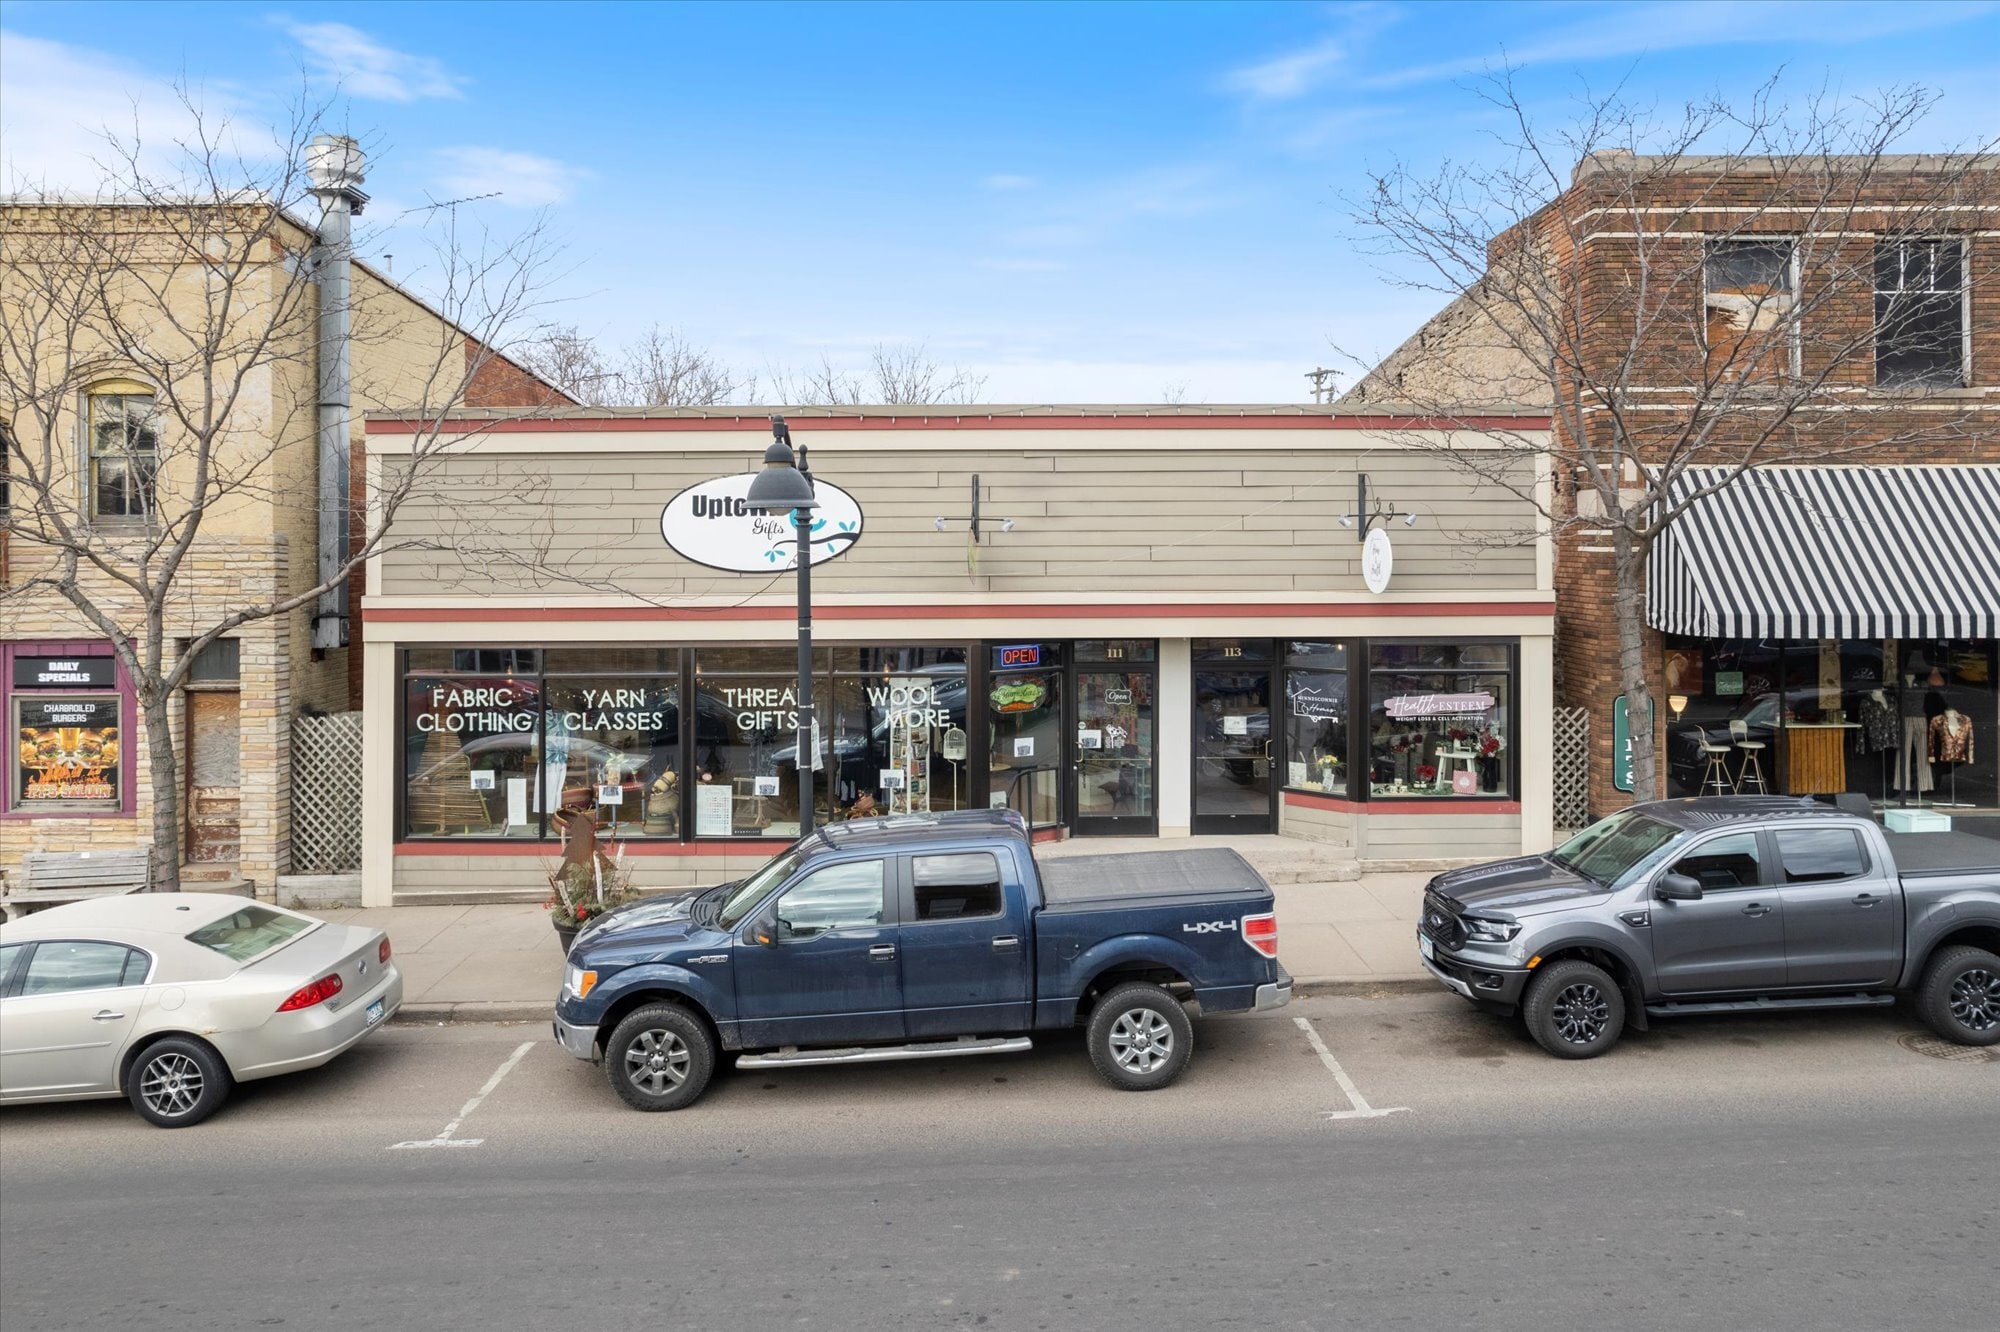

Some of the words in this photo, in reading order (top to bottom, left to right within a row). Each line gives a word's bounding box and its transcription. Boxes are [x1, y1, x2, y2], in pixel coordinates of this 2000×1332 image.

[692, 495, 776, 519] Upto
[752, 518, 785, 540] Gifts
[1003, 649, 1037, 664] OPEN
[1107, 648, 1123, 658] 111
[1224, 647, 1242, 657] 113
[49, 662, 79, 671] DAILY
[38, 673, 90, 682] SPECIALS
[433, 688, 513, 708] FABRIC
[582, 688, 645, 709] YARN
[867, 686, 942, 707] WOOL
[1108, 691, 1128, 702] Open
[1393, 693, 1438, 715] Health
[1439, 701, 1485, 711] ESTEEM
[43, 704, 95, 713] CHARBROILED
[52, 714, 87, 723] BURGERS
[884, 708, 951, 729] MORE
[416, 711, 533, 732] CLOTHING
[563, 711, 663, 731] CLASSES
[736, 710, 800, 731] GIFTS
